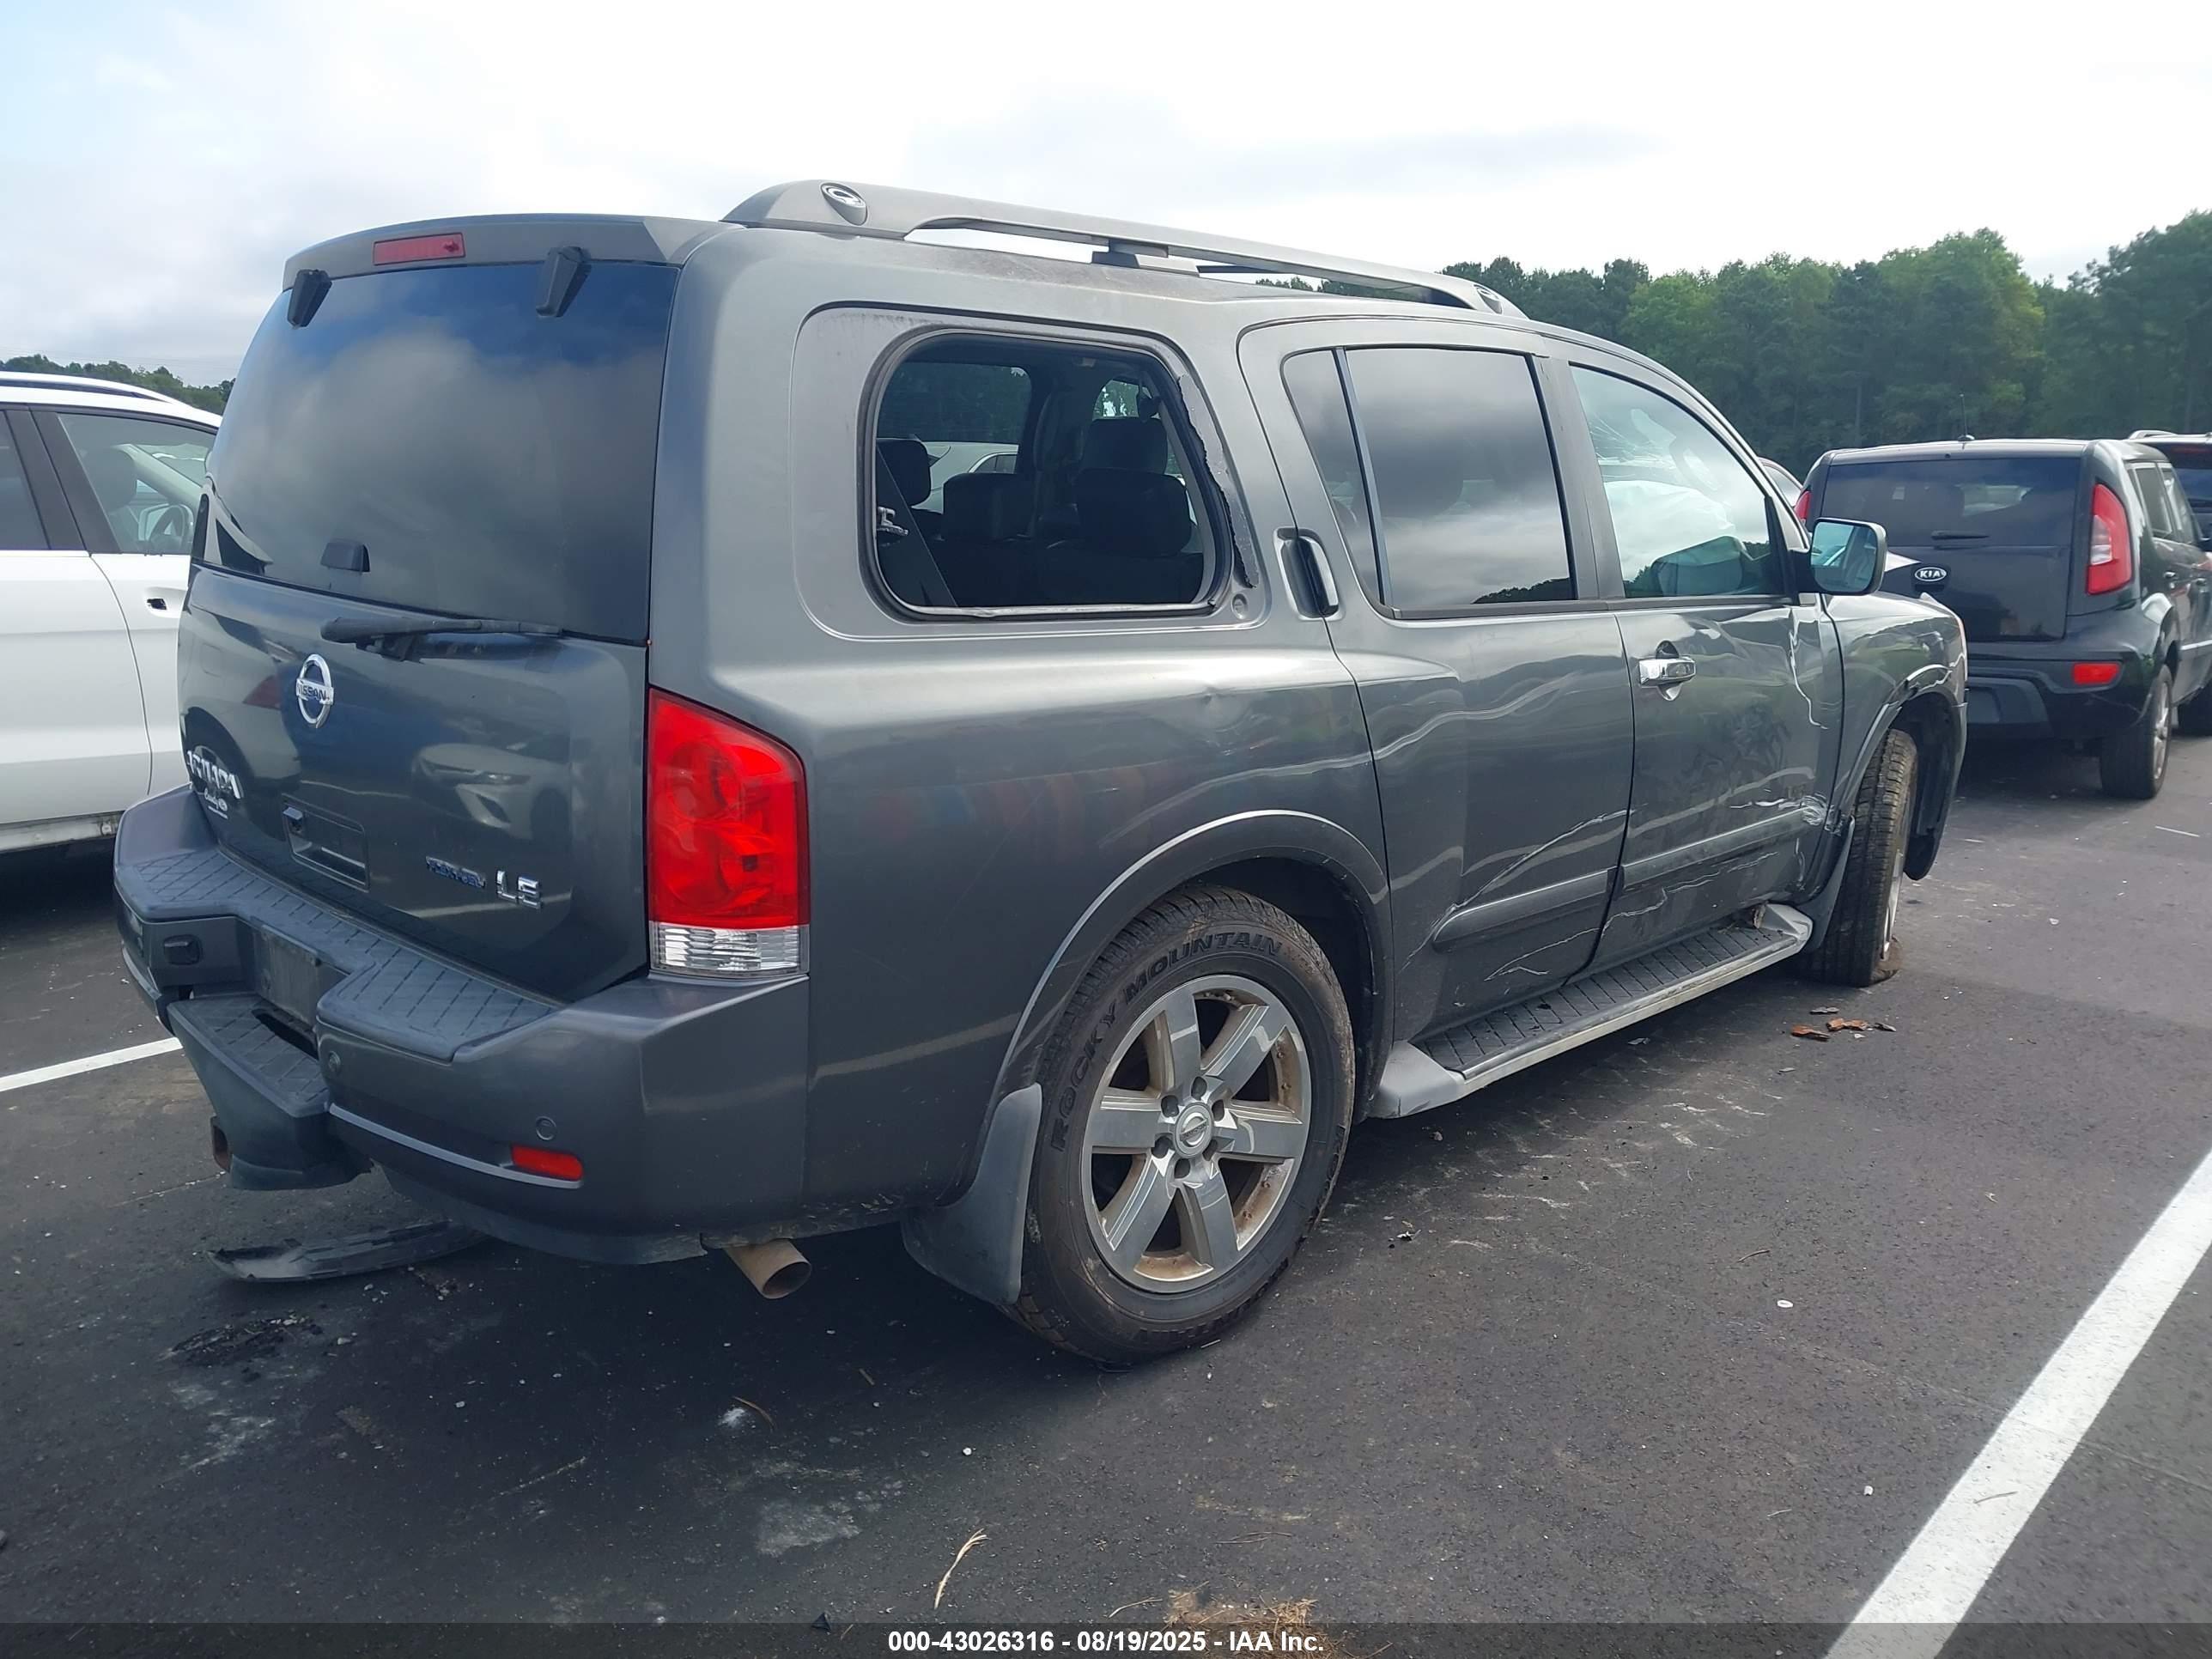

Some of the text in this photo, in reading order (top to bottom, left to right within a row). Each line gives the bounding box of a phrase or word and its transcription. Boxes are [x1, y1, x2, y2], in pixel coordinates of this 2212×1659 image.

[1919, 569, 1942, 579] KIA
[496, 870, 543, 910] LE
[1050, 931, 1283, 1152] ROCKY MOUNTAIN
